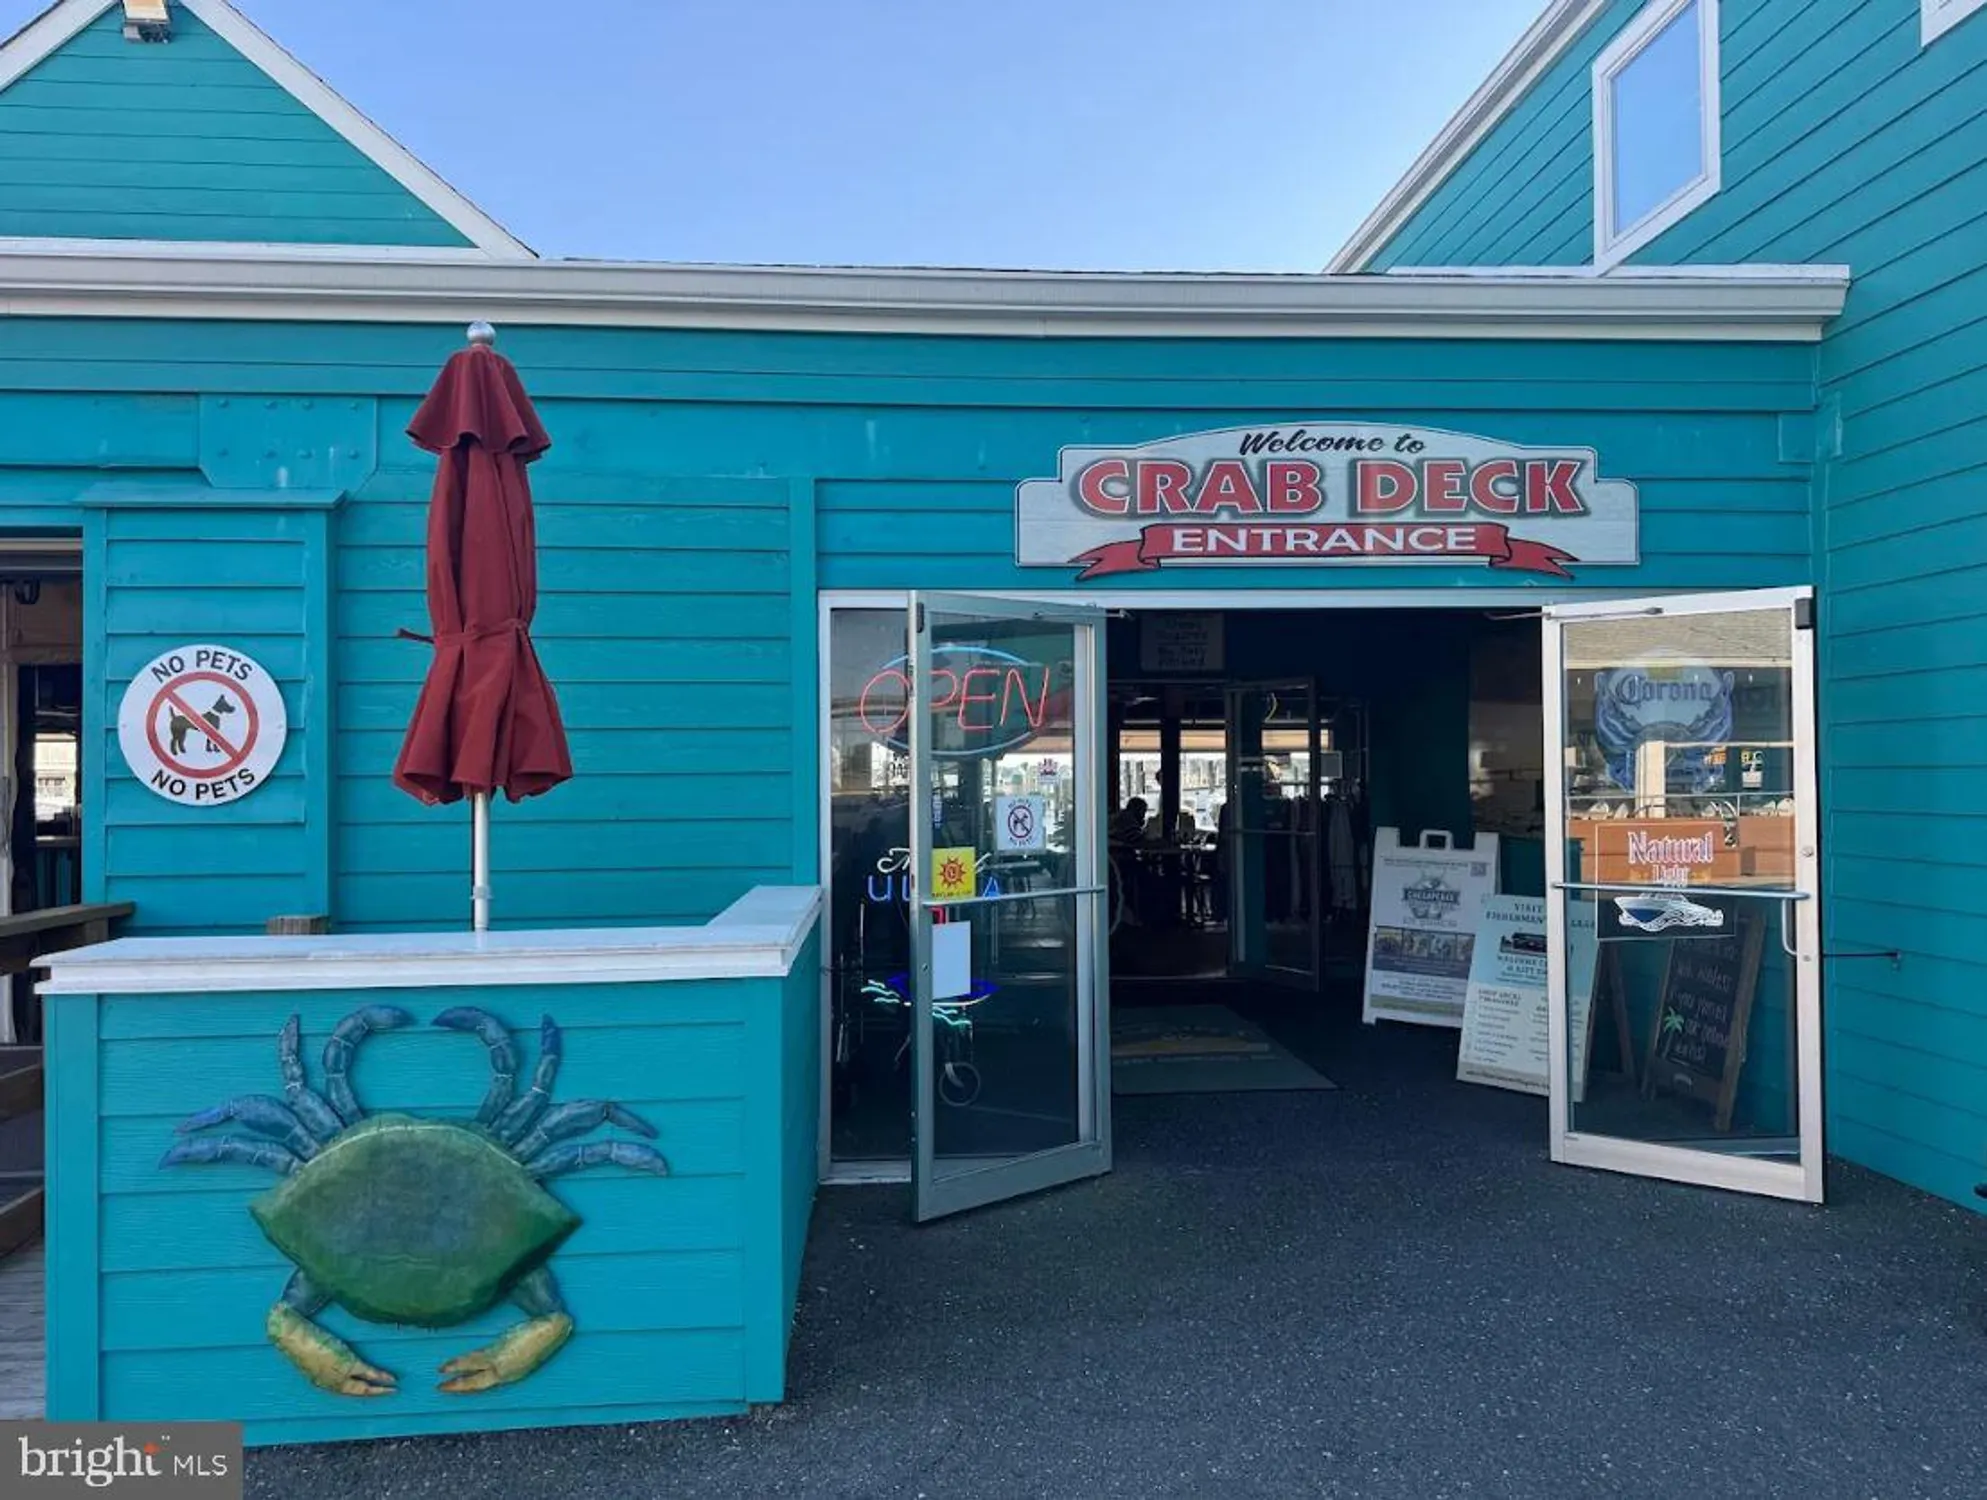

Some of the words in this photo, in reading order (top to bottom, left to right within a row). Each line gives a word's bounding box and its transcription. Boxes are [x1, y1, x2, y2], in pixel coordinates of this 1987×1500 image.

[1239, 432, 1384, 456] Welcome
[1393, 434, 1428, 454] to
[1078, 458, 1325, 515] CRAB
[1356, 458, 1589, 515] DECK
[1171, 526, 1476, 552] ENTRANCE
[151, 655, 185, 683] NO
[196, 650, 253, 681] PETS
[860, 666, 1049, 733] OPEN
[1616, 674, 1712, 710] Corona
[151, 769, 186, 796] NO
[195, 767, 255, 800] PETS
[1627, 831, 1714, 865] Natural
